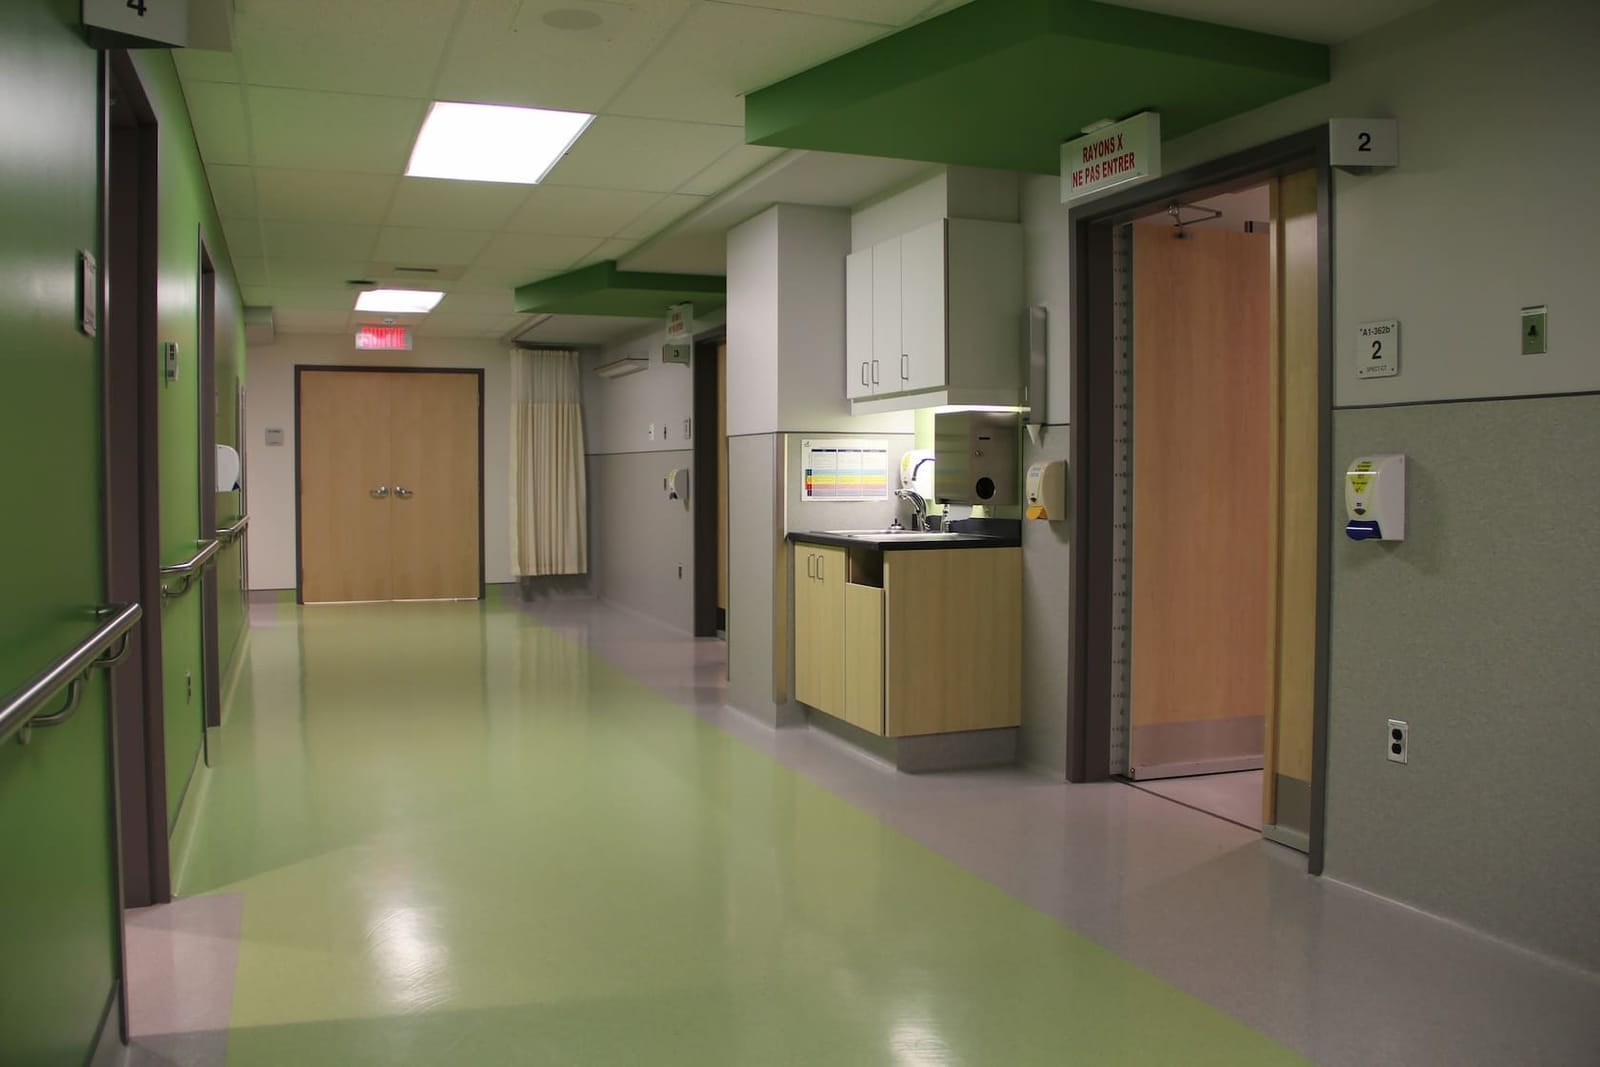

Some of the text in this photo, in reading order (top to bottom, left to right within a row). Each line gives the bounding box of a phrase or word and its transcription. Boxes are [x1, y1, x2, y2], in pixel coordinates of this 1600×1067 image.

[126, 0, 147, 16] 4
[1082, 132, 1124, 164] RAYONS X
[1358, 132, 1371, 152] 2
[1072, 151, 1135, 188] NE PAS ENTRER
[1371, 340, 1382, 360] 2
